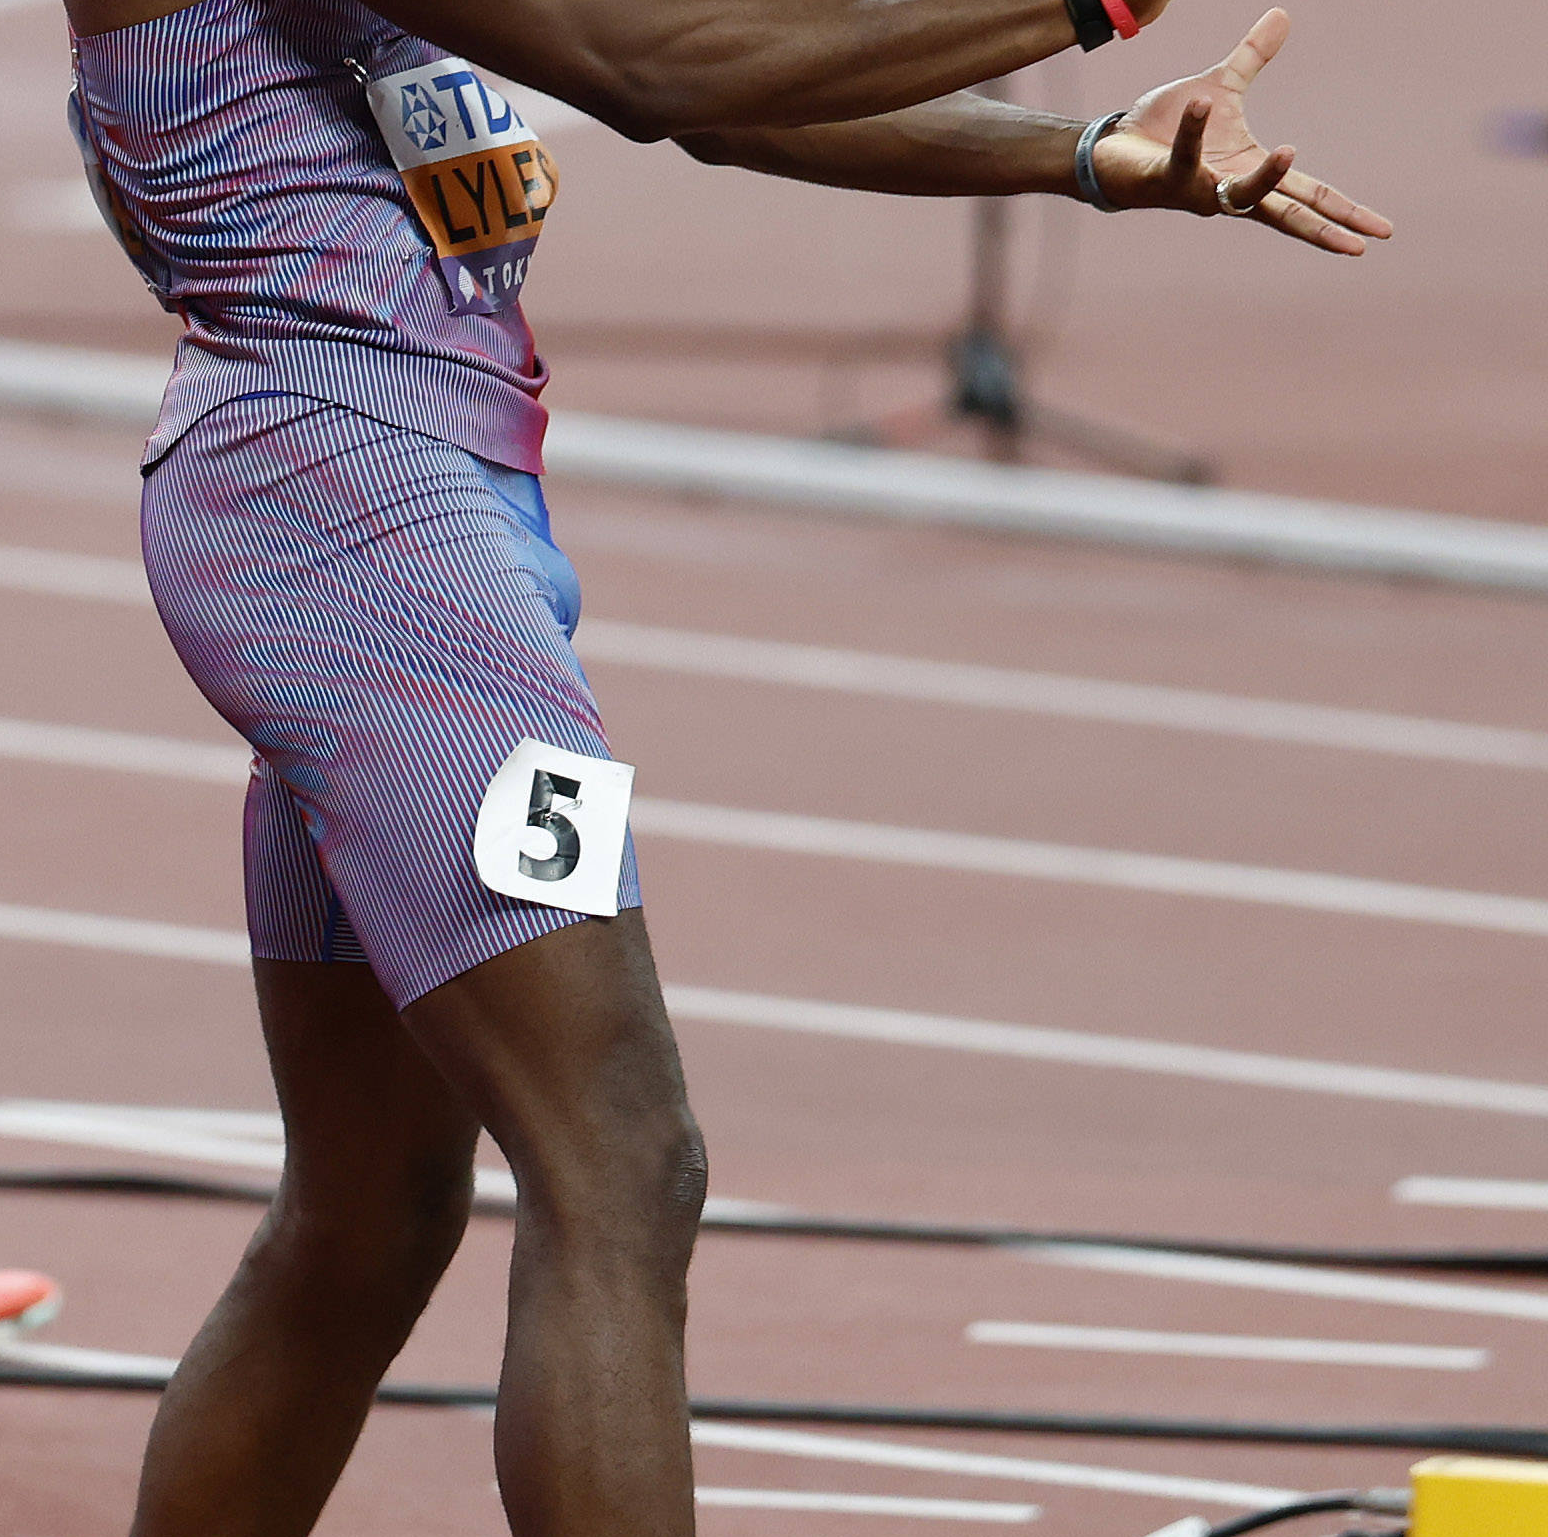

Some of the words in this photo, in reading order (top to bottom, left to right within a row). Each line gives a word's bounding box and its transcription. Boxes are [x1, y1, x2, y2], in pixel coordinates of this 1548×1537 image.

[432, 70, 525, 140] TD
[483, 255, 532, 294] TOK
[518, 768, 582, 882] 5
